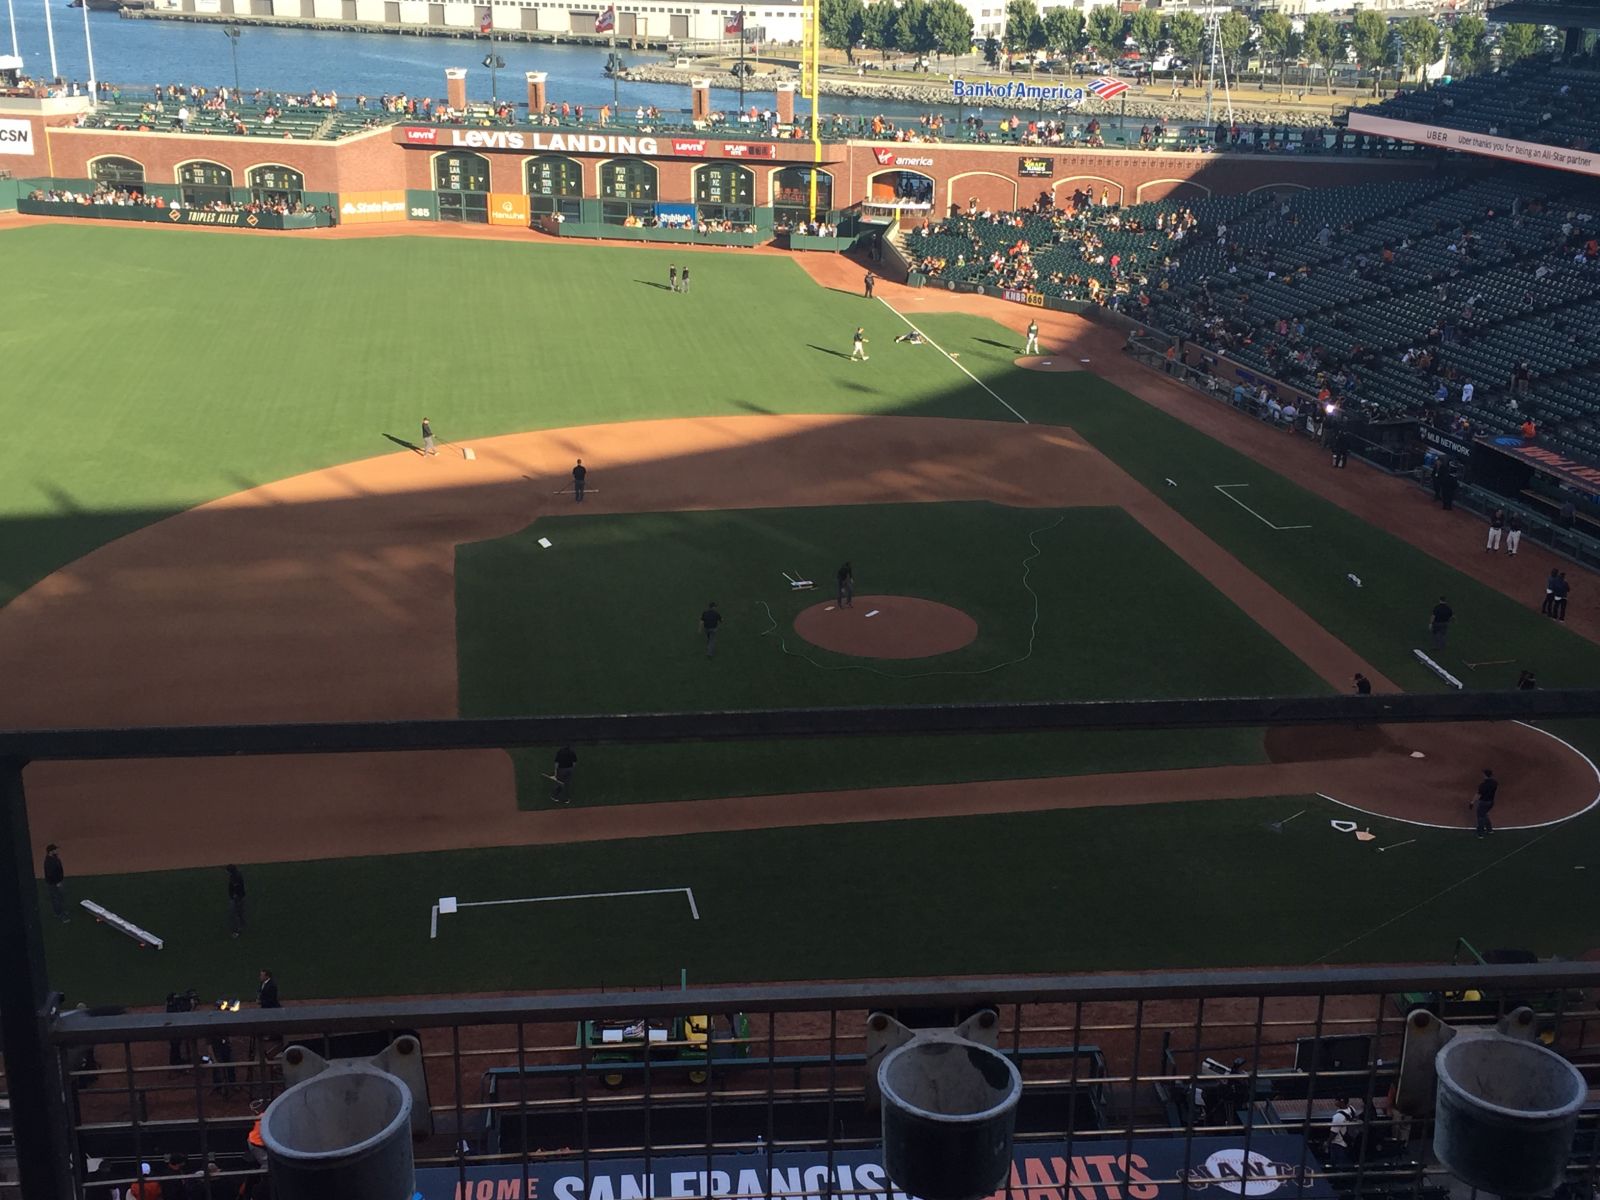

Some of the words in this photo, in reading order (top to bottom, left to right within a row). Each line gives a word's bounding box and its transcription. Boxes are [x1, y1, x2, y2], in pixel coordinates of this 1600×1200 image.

[954, 80, 995, 96] Bank
[999, 82, 1013, 96] of
[1016, 82, 1083, 99] America
[0, 129, 28, 142] CSN
[1426, 130, 1448, 142] UBER
[532, 132, 658, 155] LANDING
[1458, 135, 1472, 145] Uber
[1473, 138, 1492, 149] thanks
[1493, 142, 1504, 152] you
[1505, 143, 1514, 152] for
[1515, 145, 1533, 158] being
[1533, 149, 1541, 157] an
[1542, 150, 1566, 162] All-Star
[1566, 154, 1592, 166] partner
[896, 156, 934, 166] america
[188, 211, 216, 223] TRIPLES
[217, 213, 240, 224] ALLEY
[411, 208, 430, 217] 365
[1440, 438, 1471, 457] NETWORK
